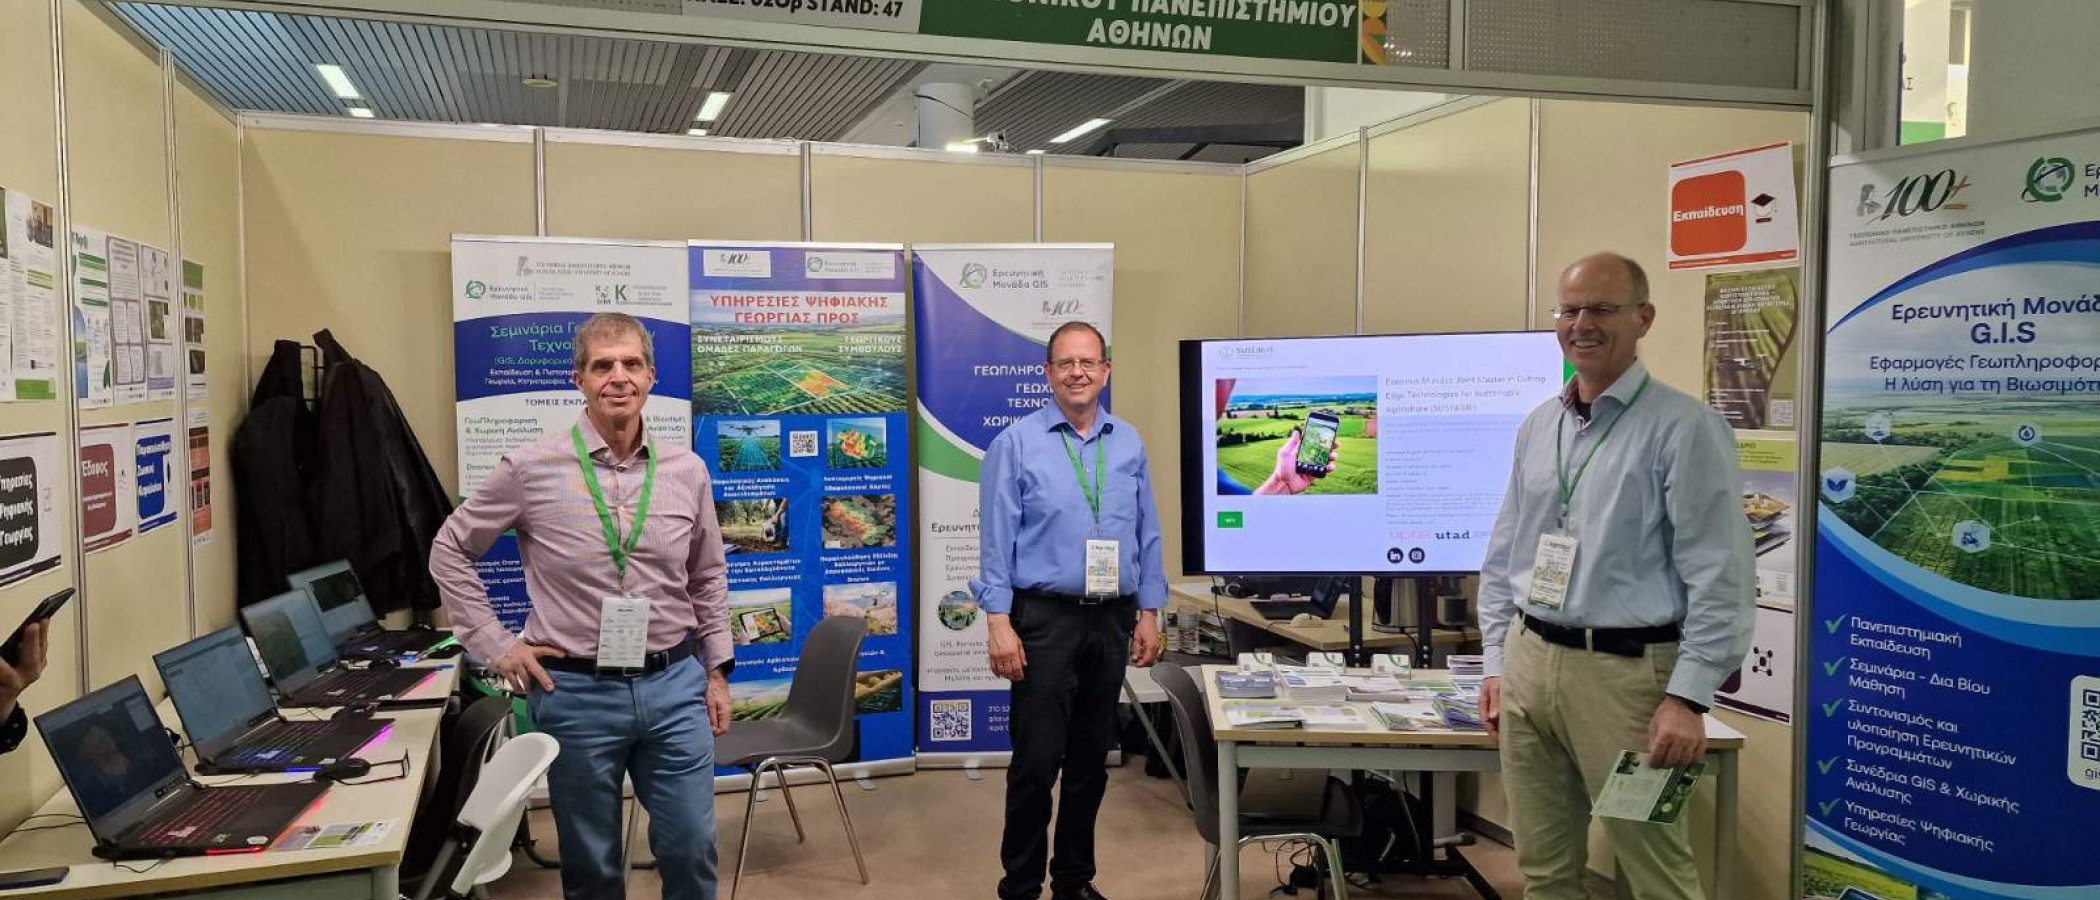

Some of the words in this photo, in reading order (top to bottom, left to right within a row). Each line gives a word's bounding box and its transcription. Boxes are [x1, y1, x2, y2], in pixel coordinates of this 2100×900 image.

[806, 0, 879, 15] STAND:
[882, 1, 903, 17] 47
[1086, 18, 1212, 50] ΑΘΗΝΩΝ
[1033, 280, 1049, 289] GIS
[710, 295, 799, 307] ΥΠΗΡΕΣΙΕΣ
[805, 296, 888, 308] ΨΗΦΙΑΚΗΣ
[1891, 298, 2015, 323] Ερευνητική
[490, 323, 563, 339] Σεμινάρια
[734, 312, 811, 324] ΓΕΩΡΓΙΑΣ
[817, 312, 860, 324] ΠΡΟΣ
[1971, 321, 2036, 344] G.I.S
[529, 339, 573, 353] Τεχνο
[1870, 354, 1964, 371] Εφαρμογές
[1884, 377, 1896, 390] Η
[1901, 376, 1943, 394] λύση
[1950, 379, 1974, 394] για
[1979, 379, 2001, 394] τη
[1434, 530, 1471, 540] utad
[1851, 616, 1962, 648] Πανεπιστημιακή
[1850, 634, 1930, 661] Εκπαίδευση
[1849, 674, 1905, 700] Μάθηση
[1850, 658, 1915, 680] Σεμινάρια
[1929, 673, 1954, 688] Δια
[1957, 678, 1990, 695] Βίου
[1848, 700, 1933, 729] Συντονισμός
[1937, 720, 1958, 733] και
[1847, 720, 1919, 746] υλοποίηση
[1923, 734, 2016, 765] Ερευνητικών
[1847, 735, 1953, 769] Προγραμμάτων
[1846, 758, 1907, 785] Συνέδρια
[1911, 775, 1935, 791] GIS
[1940, 782, 1950, 795] &
[1956, 786, 2020, 814] Χωρικής
[1846, 777, 1912, 805] Ανάλυσης
[1844, 800, 1916, 831] Υπηρεσίες
[1920, 820, 1994, 852] Ψηφιακής
[1844, 817, 1905, 846] Γεωργίας
